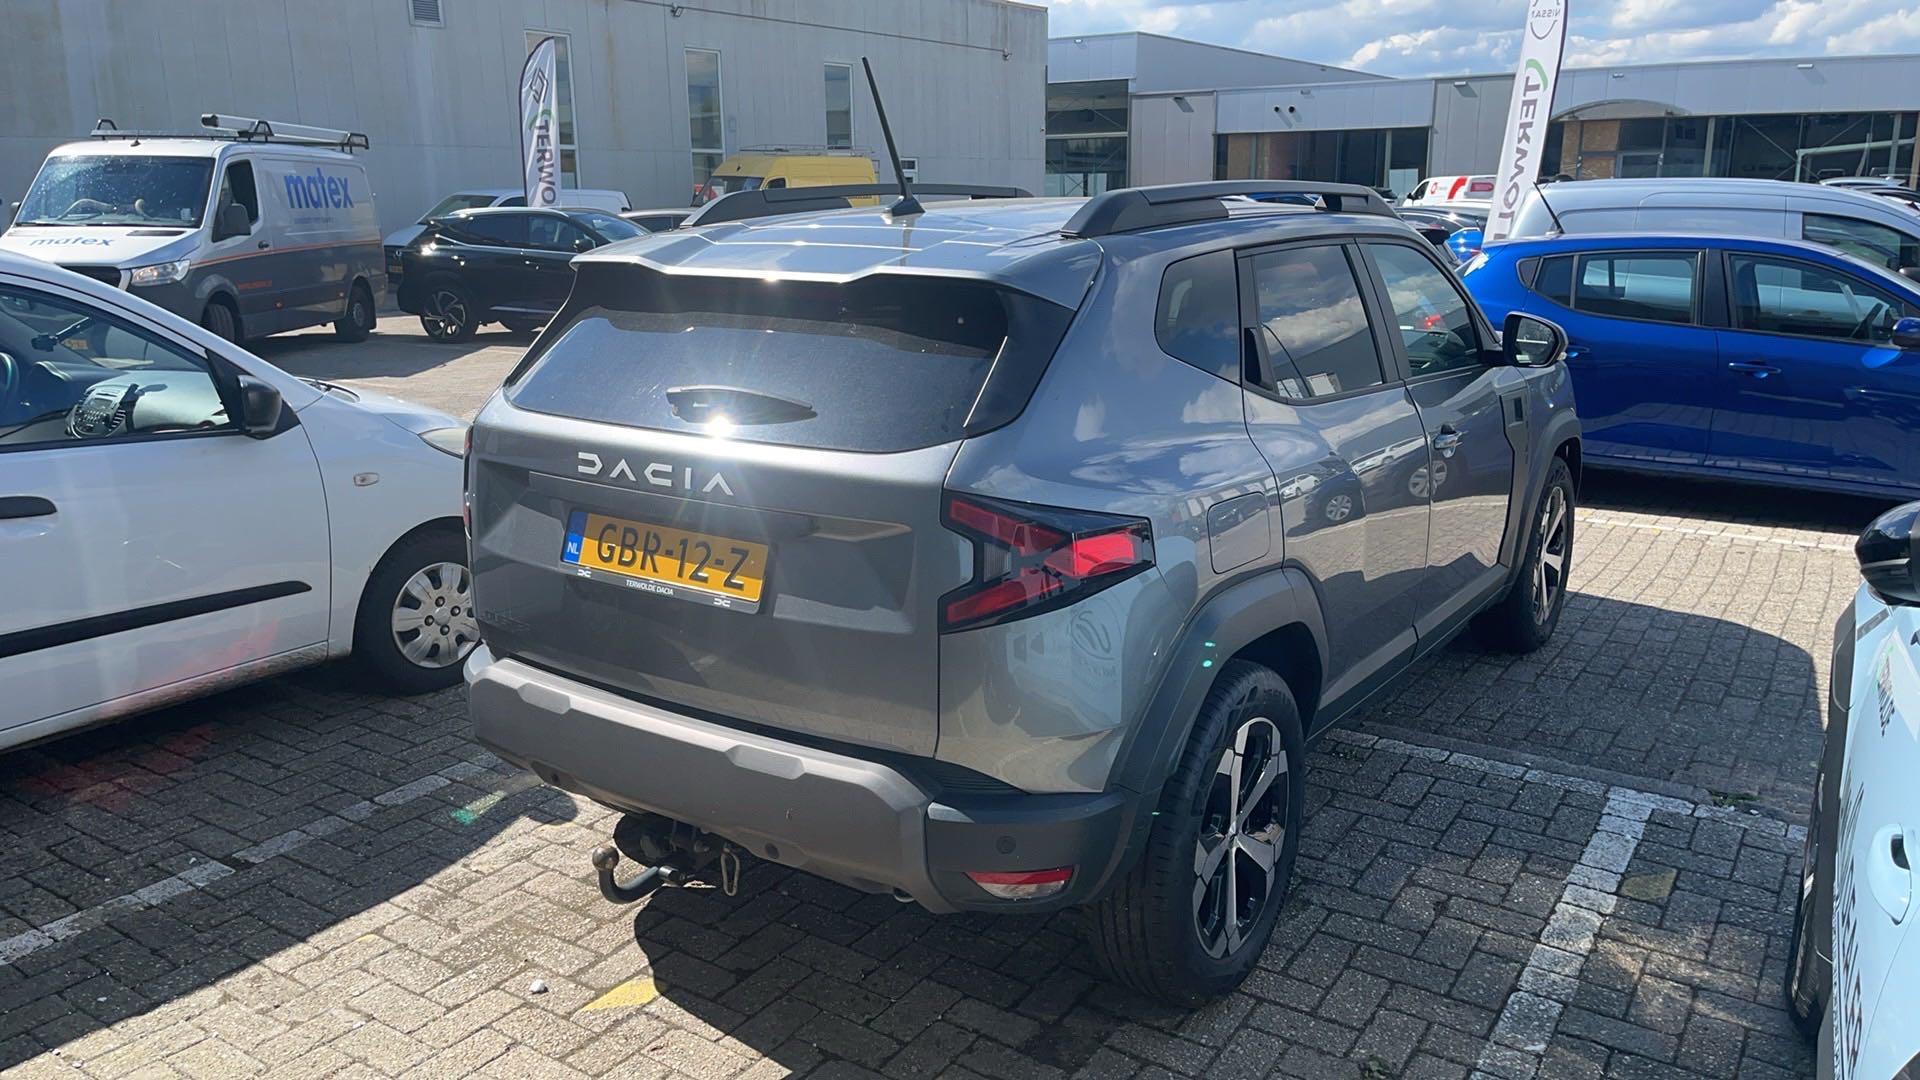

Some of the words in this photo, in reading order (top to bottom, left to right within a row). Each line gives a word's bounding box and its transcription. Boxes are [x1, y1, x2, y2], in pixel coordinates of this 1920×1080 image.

[284, 168, 354, 208] matex
[30, 236, 113, 246] matex
[577, 451, 735, 496] DACIA
[567, 541, 580, 554] NL
[597, 523, 750, 591] GBR-12-Z
[626, 579, 656, 591] TERWOLDE
[656, 585, 674, 596] DACIA
